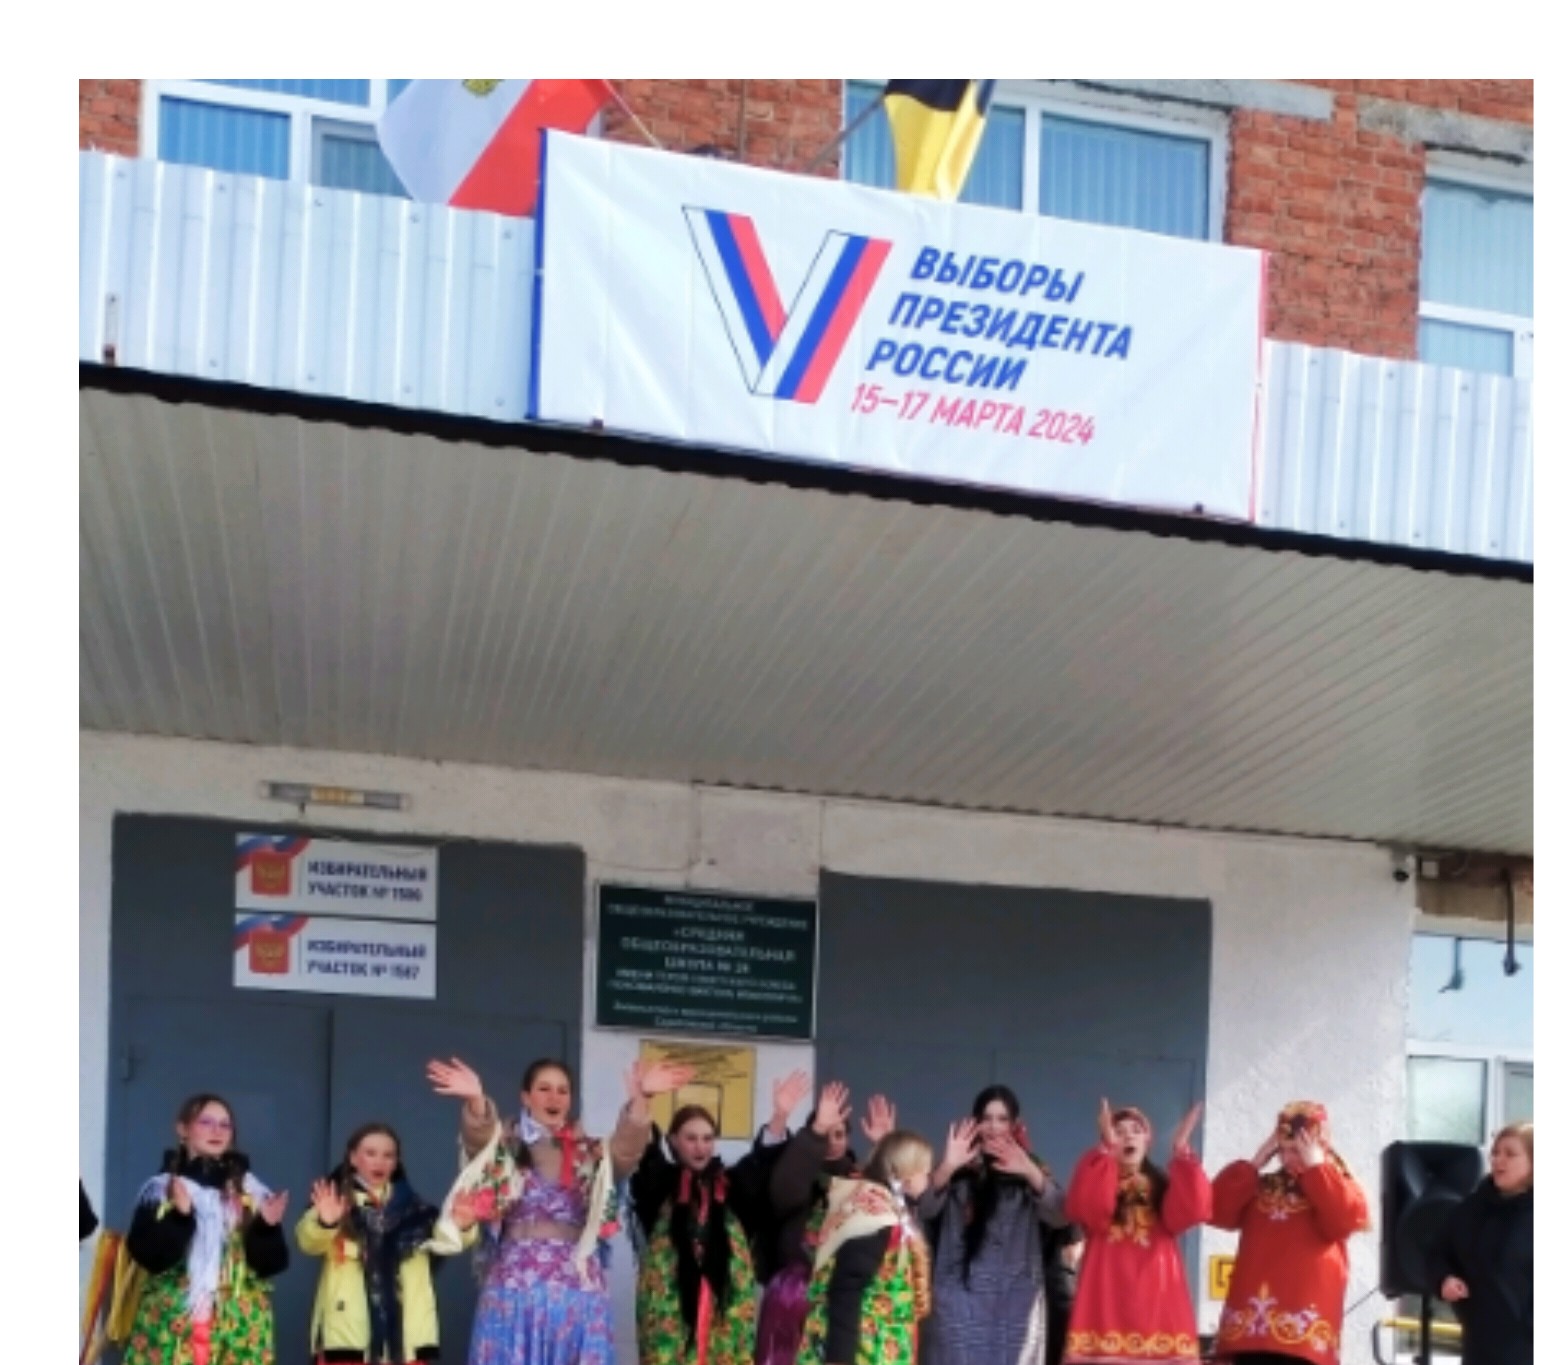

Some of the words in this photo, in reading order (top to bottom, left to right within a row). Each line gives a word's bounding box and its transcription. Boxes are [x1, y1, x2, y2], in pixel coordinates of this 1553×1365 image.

[909, 245, 1085, 304] ВЫБОРЫ
[888, 292, 1135, 361] ПРЕЗИДЕНТА
[865, 340, 1028, 392] РОССИИ
[932, 394, 1024, 437] МАРТА
[1029, 408, 1095, 446] 2024
[308, 861, 427, 881] ИЗБИРАТЕЛЬНЫЙ
[308, 881, 368, 897] УЧАСТОК
[308, 940, 426, 958] ИЗБИРАТЕЛЬНЫЙ
[308, 960, 367, 976] УЧАСТОК
